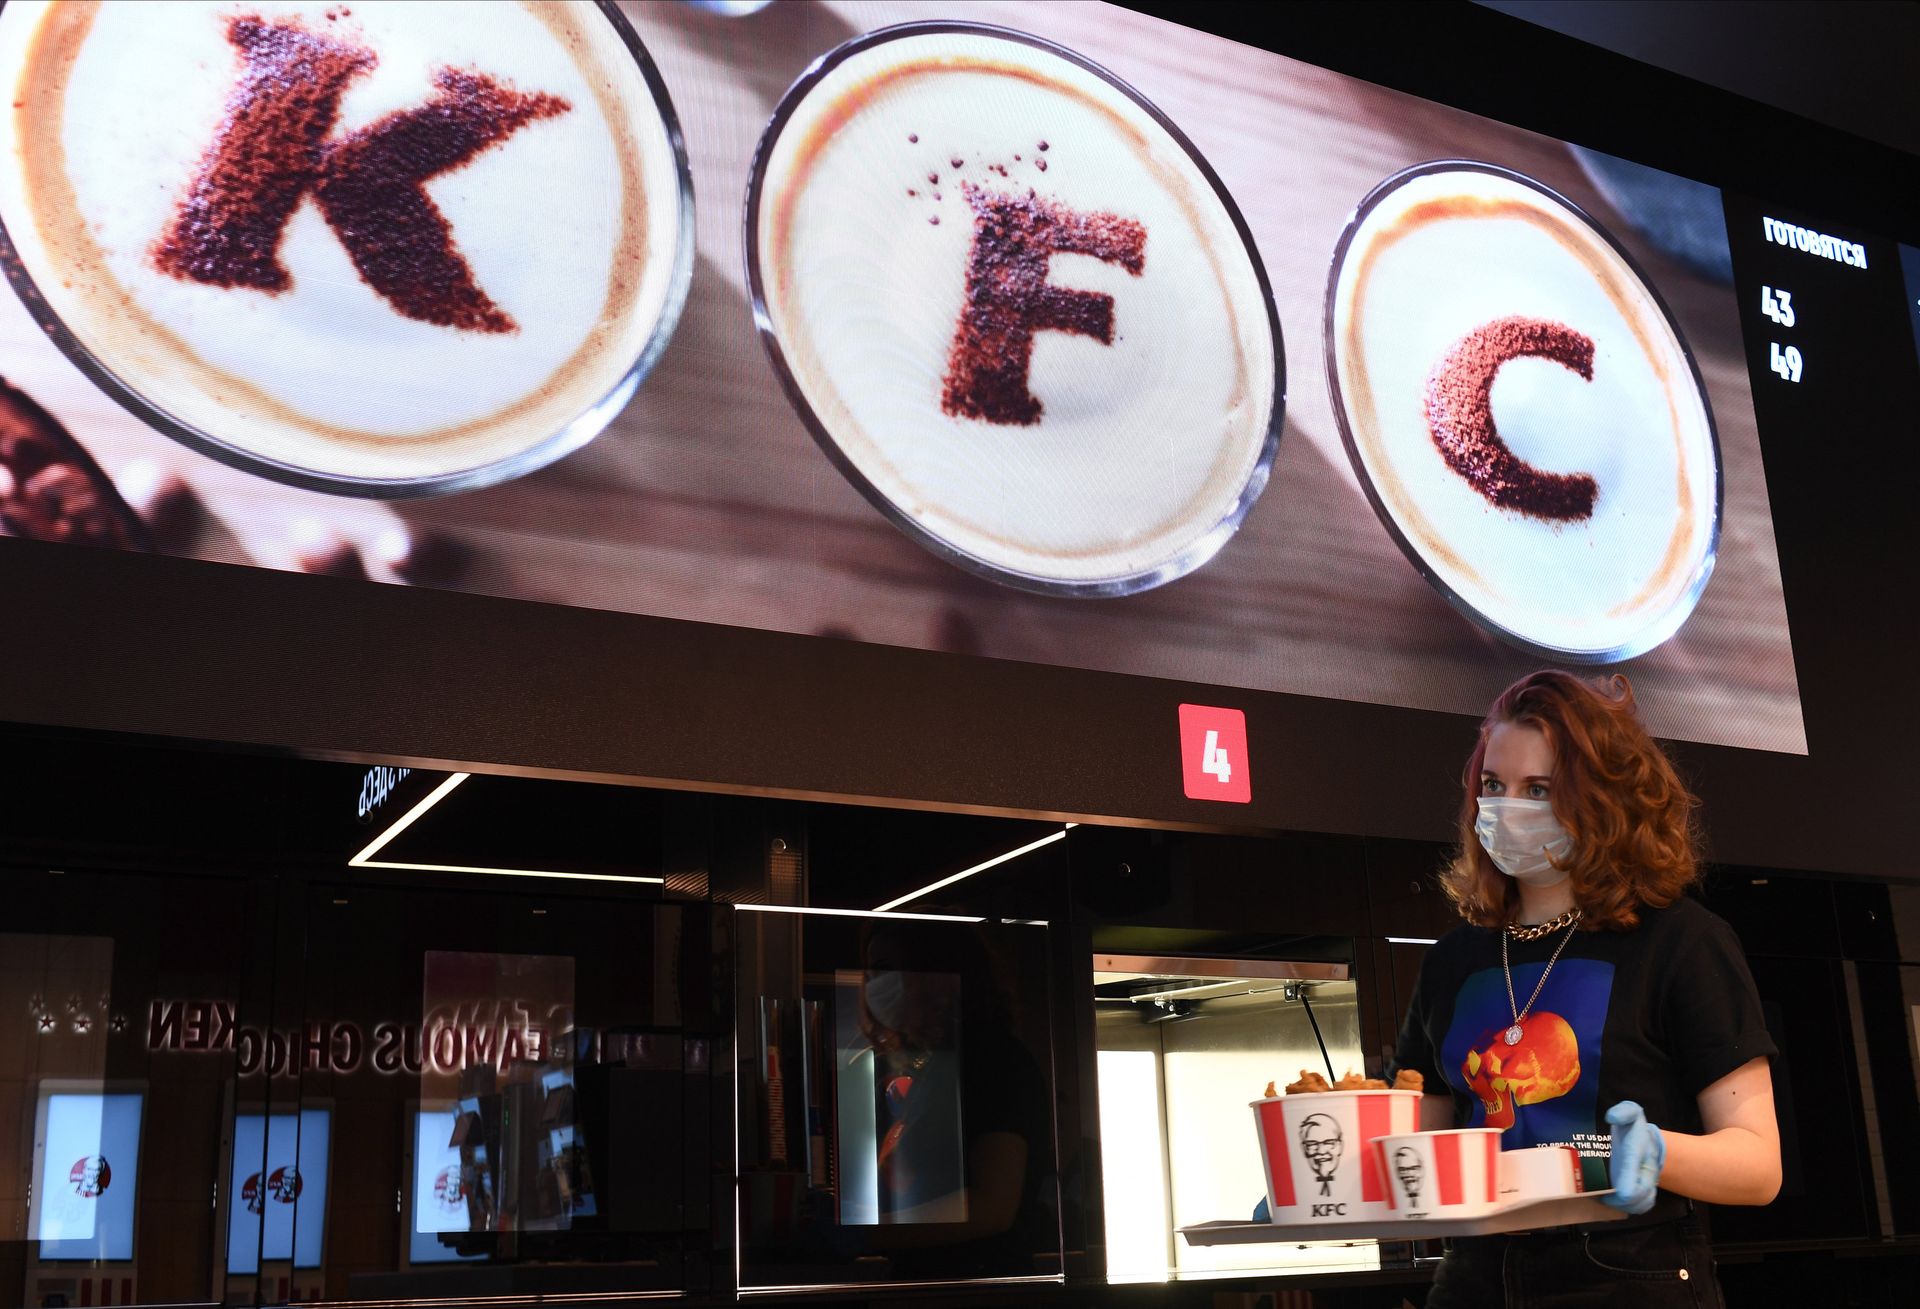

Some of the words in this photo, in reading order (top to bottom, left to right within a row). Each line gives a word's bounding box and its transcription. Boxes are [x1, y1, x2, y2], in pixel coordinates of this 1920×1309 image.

[1763, 216, 1868, 270] ГОТОВЯТСЯ
[149, 14, 572, 335] K
[940, 182, 1147, 426] F
[1424, 315, 1599, 524] C
[1761, 285, 1796, 328] 43
[1769, 341, 1804, 383] 49
[1202, 730, 1232, 783] 4
[1572, 1133, 1585, 1141] LET
[1312, 1203, 1347, 1217] KFC
